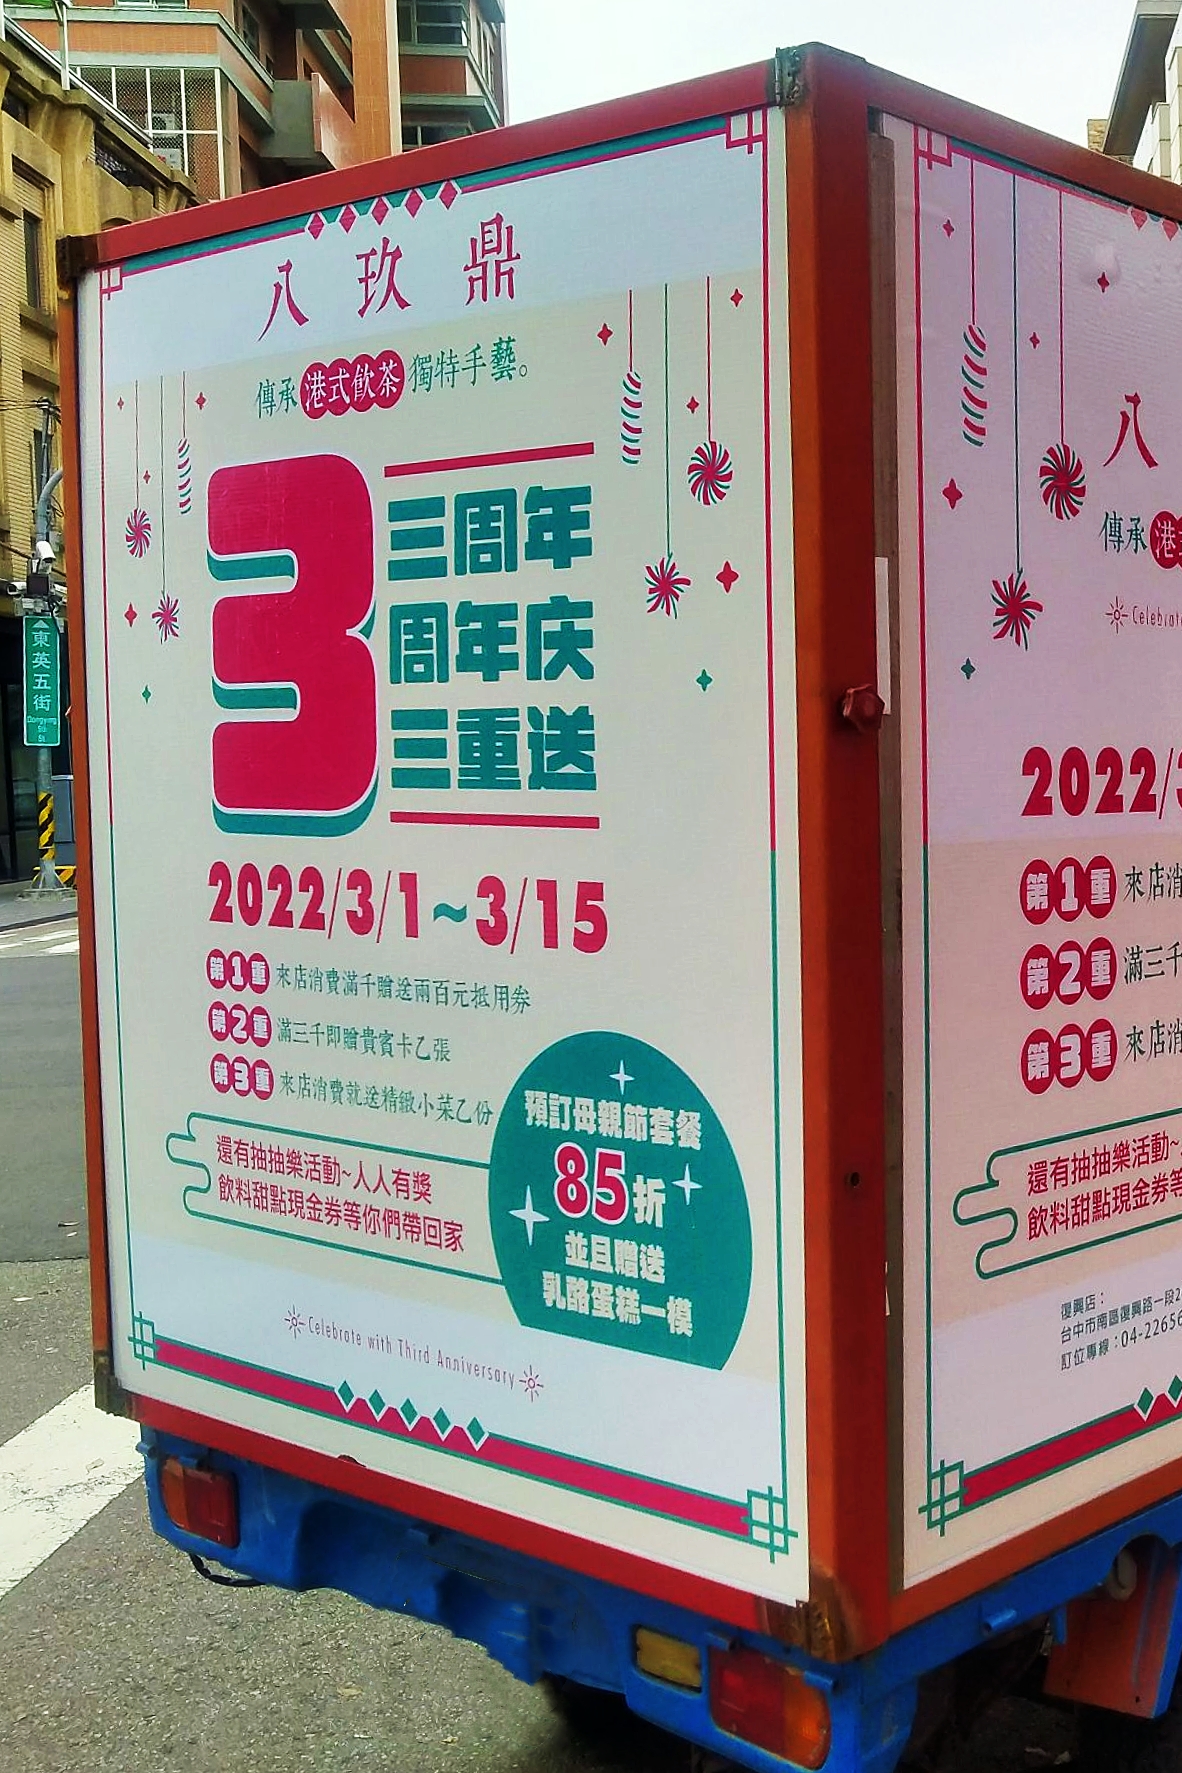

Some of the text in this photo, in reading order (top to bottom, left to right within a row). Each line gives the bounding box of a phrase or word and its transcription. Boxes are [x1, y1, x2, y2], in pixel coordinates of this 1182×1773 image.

[386, 484, 593, 582] 三周年
[207, 452, 377, 838] 3
[389, 594, 595, 687] 周年庆
[32, 631, 51, 711] 東英五街
[389, 705, 597, 792] 三重送
[207, 860, 609, 954] 2022/3/1~3/15
[1026, 865, 1110, 913] 第1重
[209, 954, 268, 987] 第1重
[1026, 947, 1111, 997] 第2重
[211, 1005, 270, 1041] 第2重
[212, 1056, 271, 1094] 第3重
[1026, 1029, 1111, 1080] 第3重
[524, 1090, 701, 1150] 預訂母親節套餐
[218, 1173, 464, 1252] 飲料甜點現金券等你們帶回家
[565, 1230, 665, 1284] 並且贈送
[367, 1333, 392, 1355] with
[398, 1338, 430, 1364] Third
[438, 1349, 515, 1390] Anniversary
